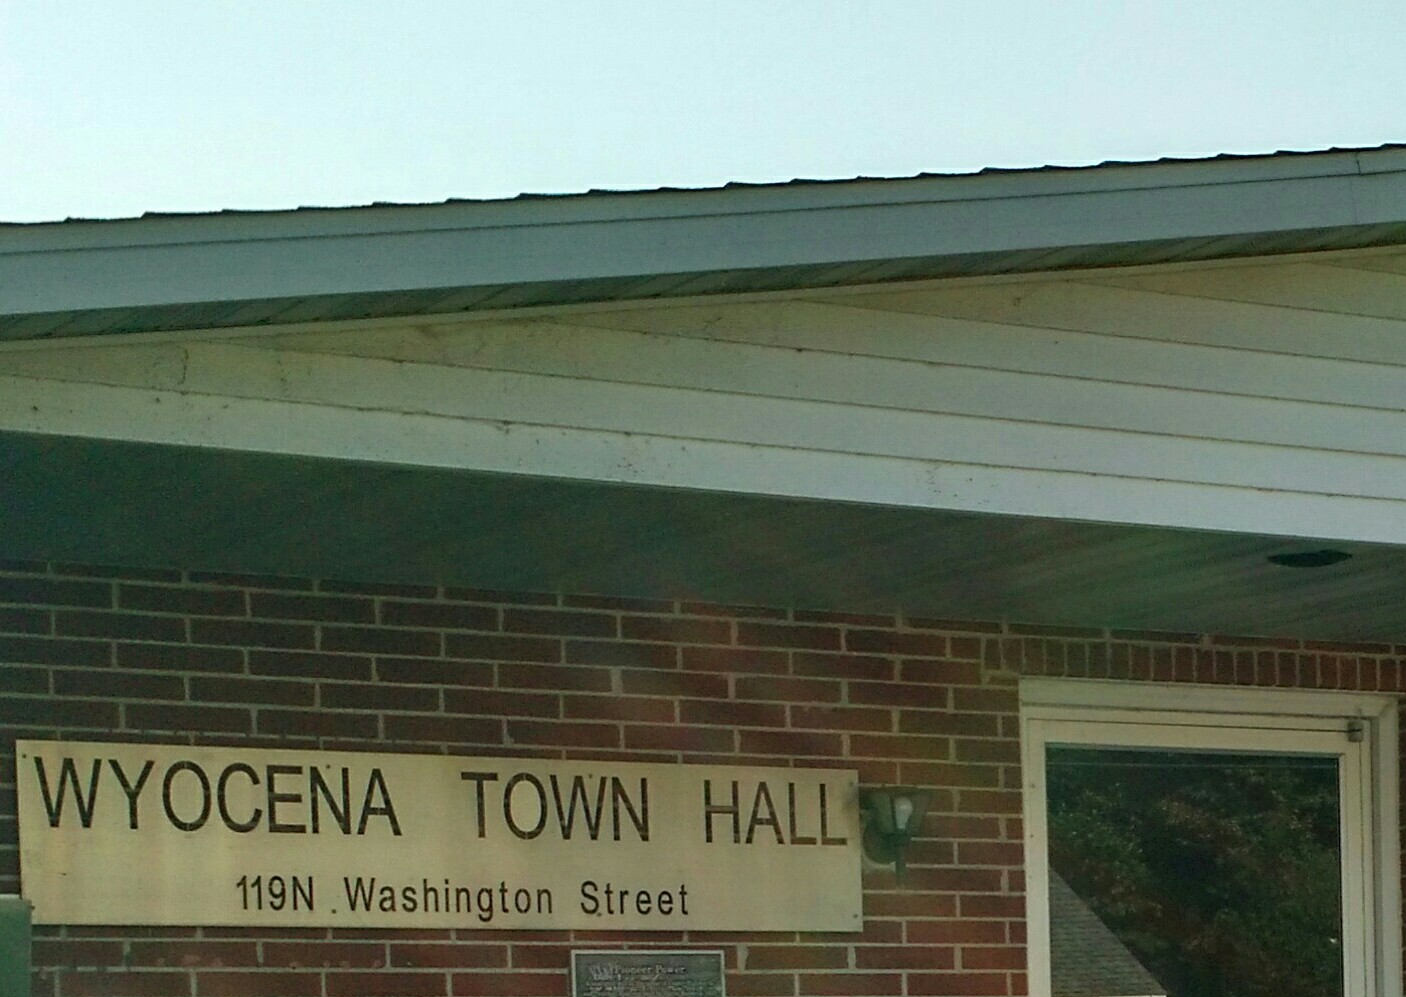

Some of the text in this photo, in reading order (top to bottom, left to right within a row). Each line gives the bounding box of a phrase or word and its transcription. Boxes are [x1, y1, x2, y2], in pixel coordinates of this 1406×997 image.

[33, 755, 849, 847] WYOCENA TOWN HALL
[343, 875, 553, 923] Washington
[580, 880, 689, 916] Street
[614, 963, 687, 975] Pioneer Power
